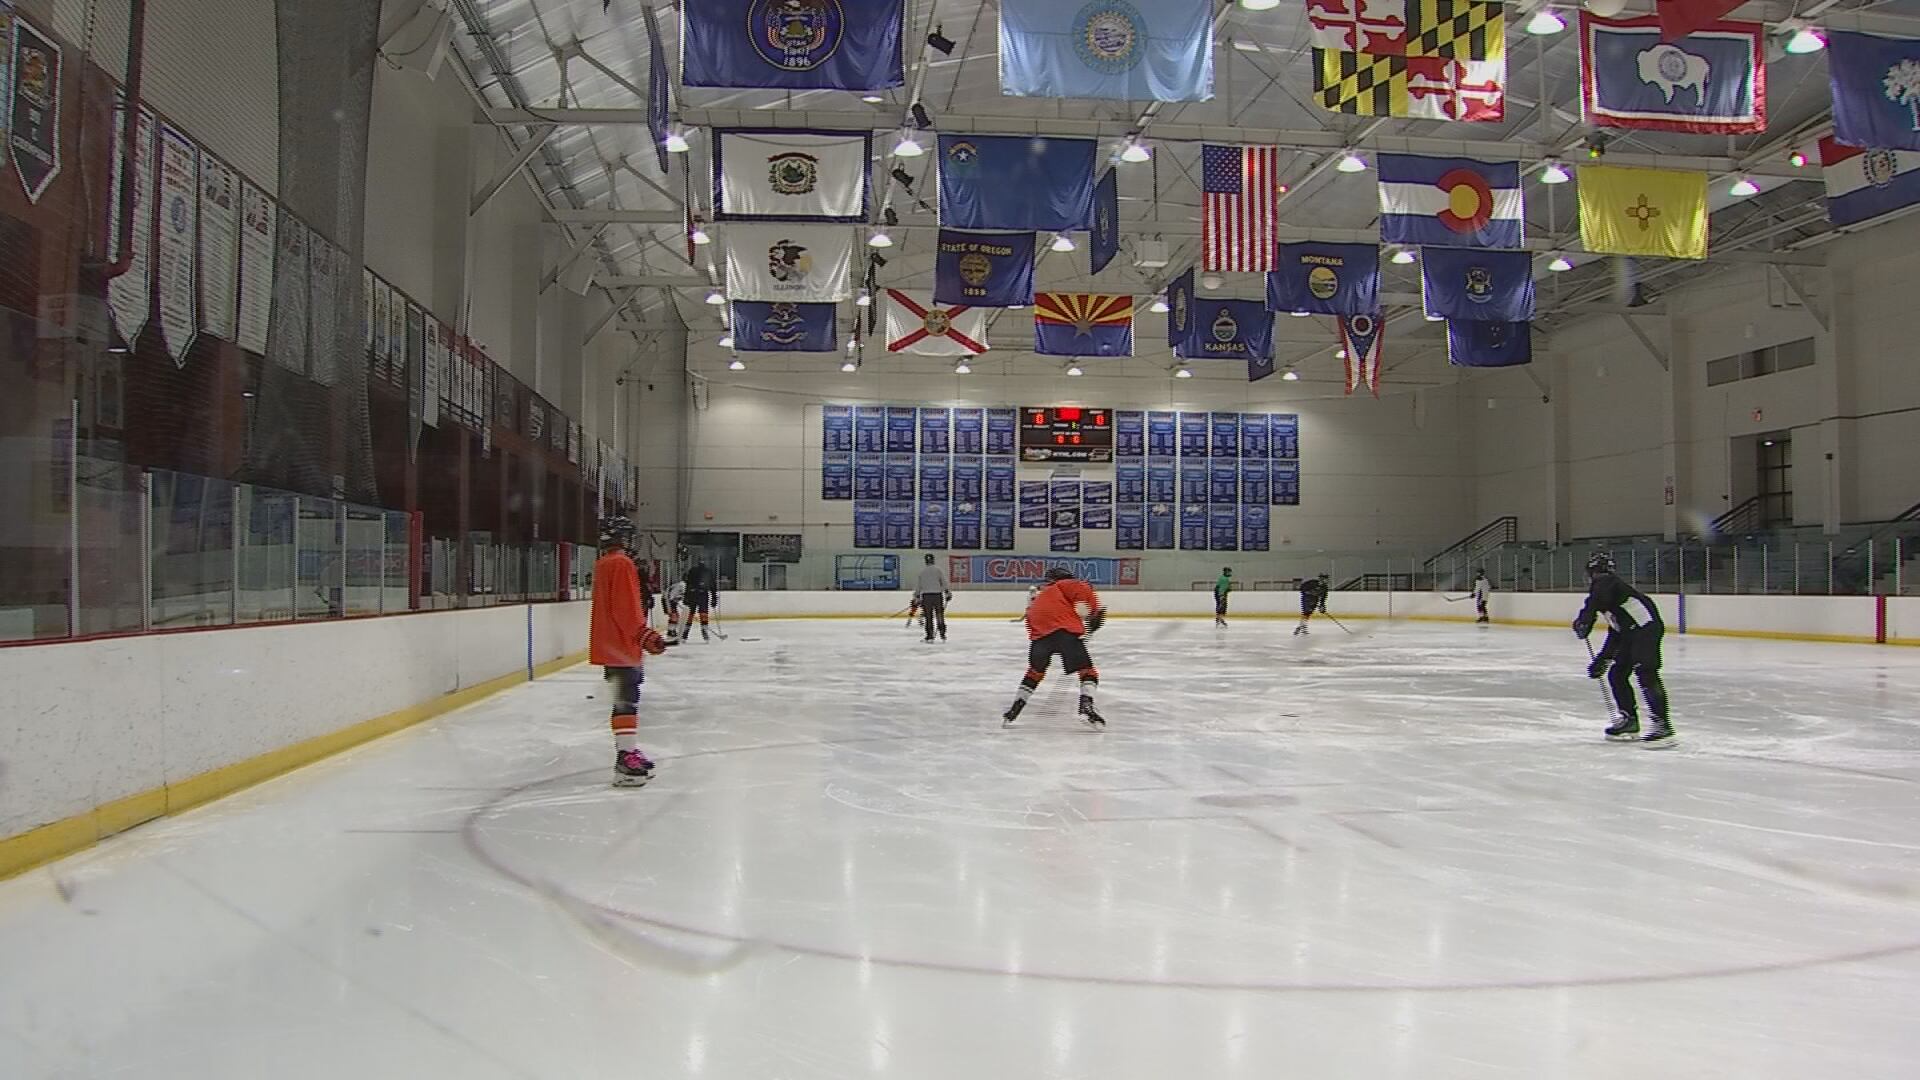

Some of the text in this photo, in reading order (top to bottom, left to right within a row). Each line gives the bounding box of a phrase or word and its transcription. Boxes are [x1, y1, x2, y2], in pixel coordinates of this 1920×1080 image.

[783, 57, 811, 67] 1896
[941, 243, 1013, 256] STATE OF OREGON
[1301, 255, 1344, 266] MONTANA
[1204, 342, 1246, 352] KANSAS
